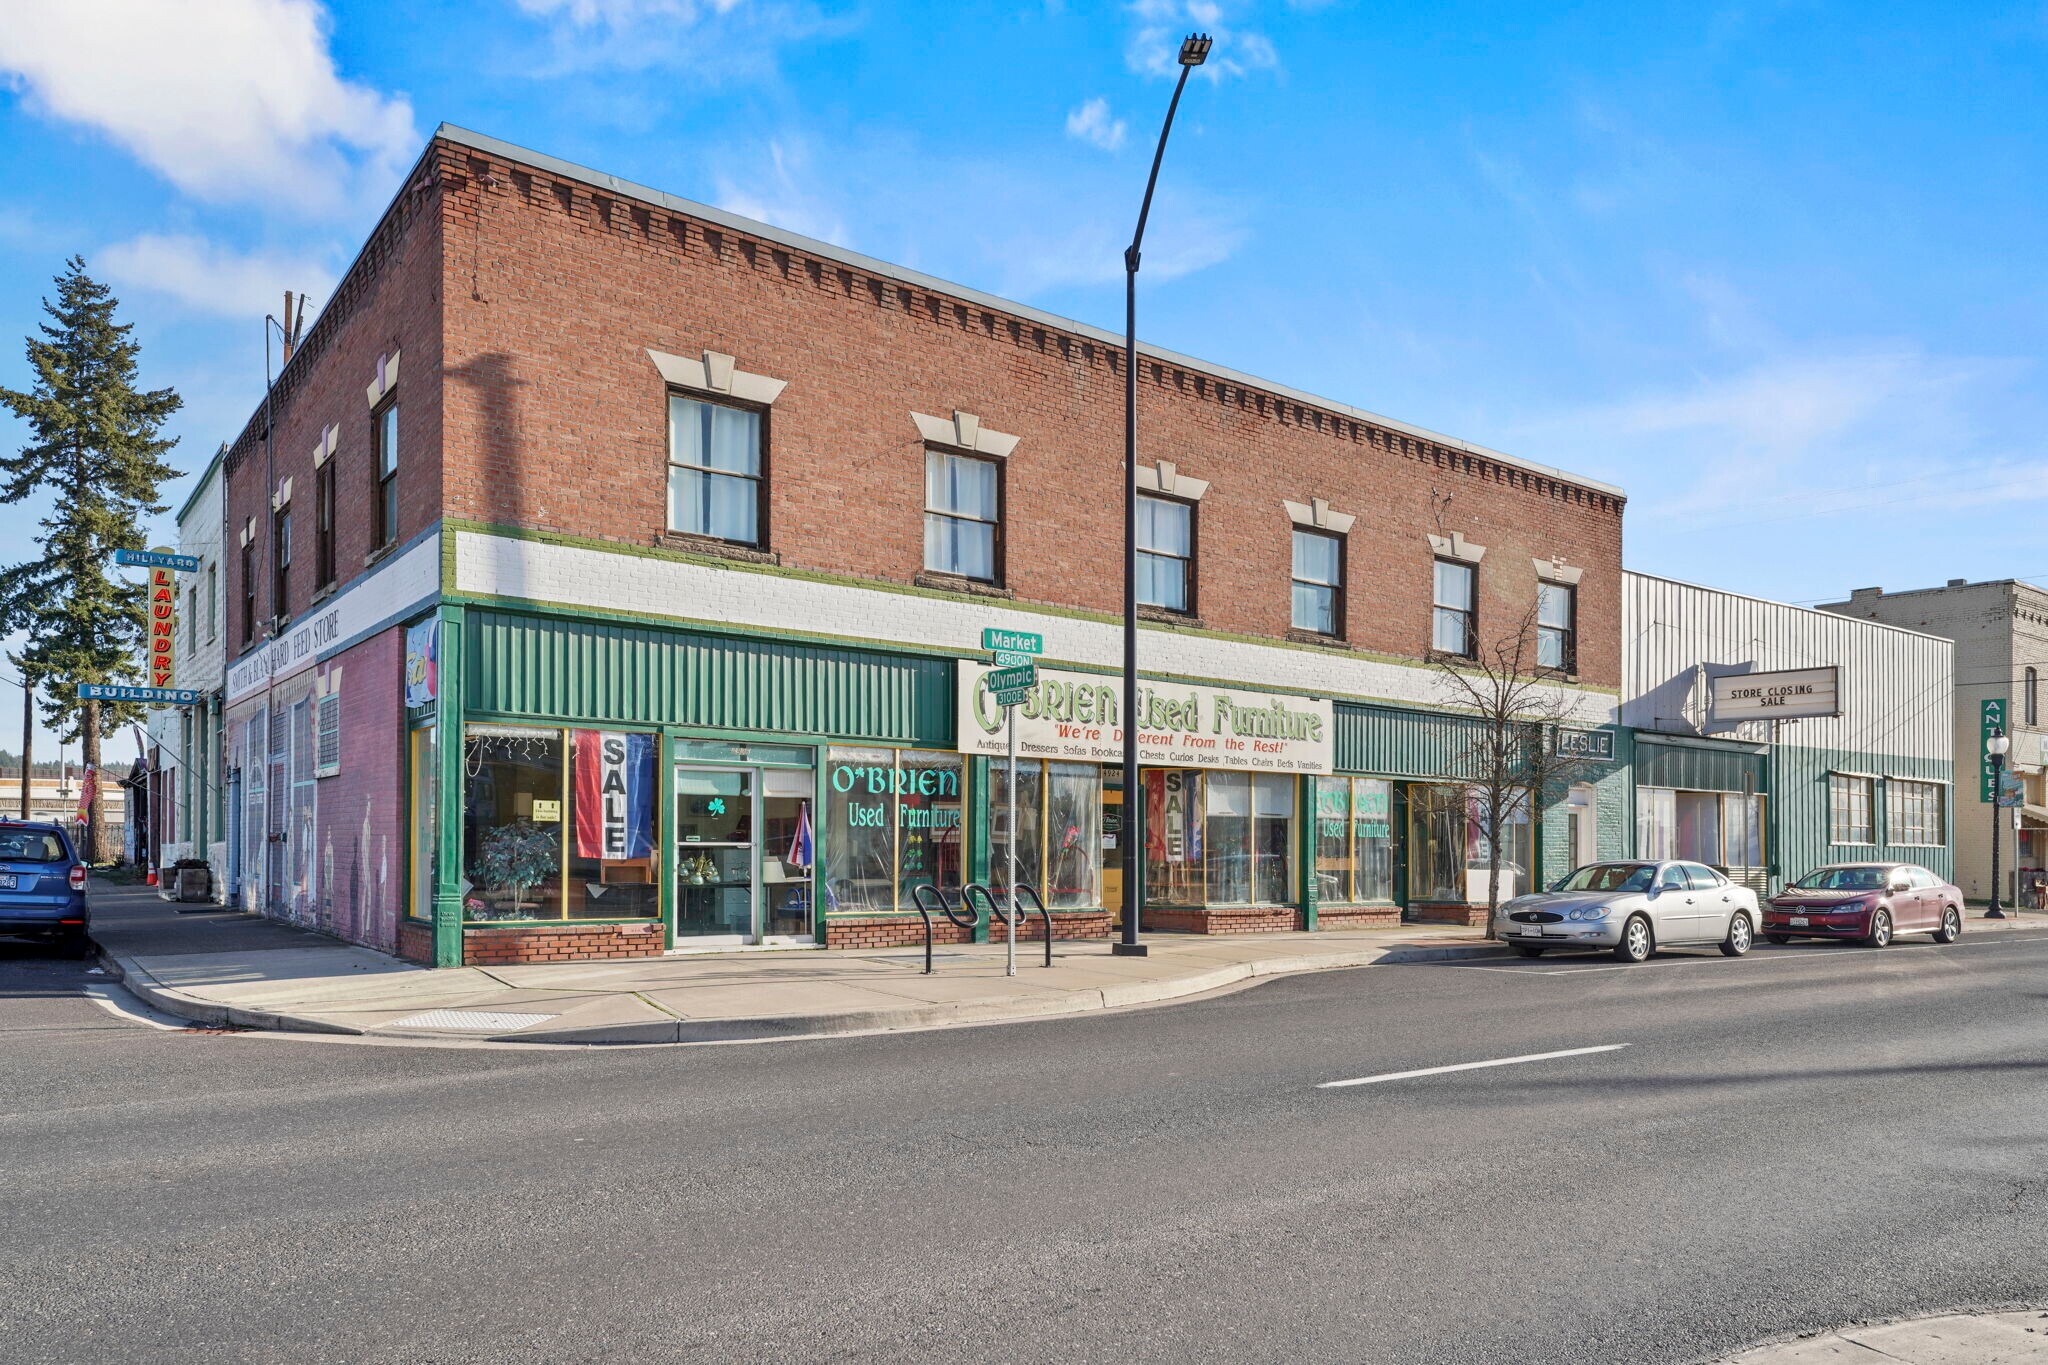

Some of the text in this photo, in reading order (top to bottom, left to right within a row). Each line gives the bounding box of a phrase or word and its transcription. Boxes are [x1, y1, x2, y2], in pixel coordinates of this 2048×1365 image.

[126, 552, 195, 568] HILLYARD
[153, 570, 173, 687] LAUNDRY
[293, 627, 311, 660] FEED
[314, 609, 339, 649] STORE
[991, 631, 1037, 652] Market
[989, 667, 1032, 689] Olympic
[998, 690, 1023, 705] 3100E
[1731, 685, 1813, 699] STORE CLOSING
[1760, 697, 1785, 707] SALE
[1136, 686, 1199, 733] Used
[1212, 694, 1324, 743] Furniture
[1182, 734, 1216, 749] From
[1225, 738, 1245, 751] the
[1561, 733, 1609, 753] LESLIE
[1021, 742, 1059, 755] Dressers
[1063, 745, 1087, 756] Sofas
[1139, 749, 1166, 761] Chests
[1169, 752, 1194, 763] Curios
[1198, 753, 1220, 764] Desks
[1224, 755, 1248, 766] Tables
[1251, 757, 1274, 768] Chairs
[1277, 759, 1294, 769] Beds
[1297, 760, 1323, 770] Vanities
[1103, 769, 1120, 777] 4924
[602, 738, 627, 853] SALE
[848, 802, 961, 828] Used Furniture
[1166, 773, 1183, 856] SALE
[1323, 818, 1345, 837] Used
